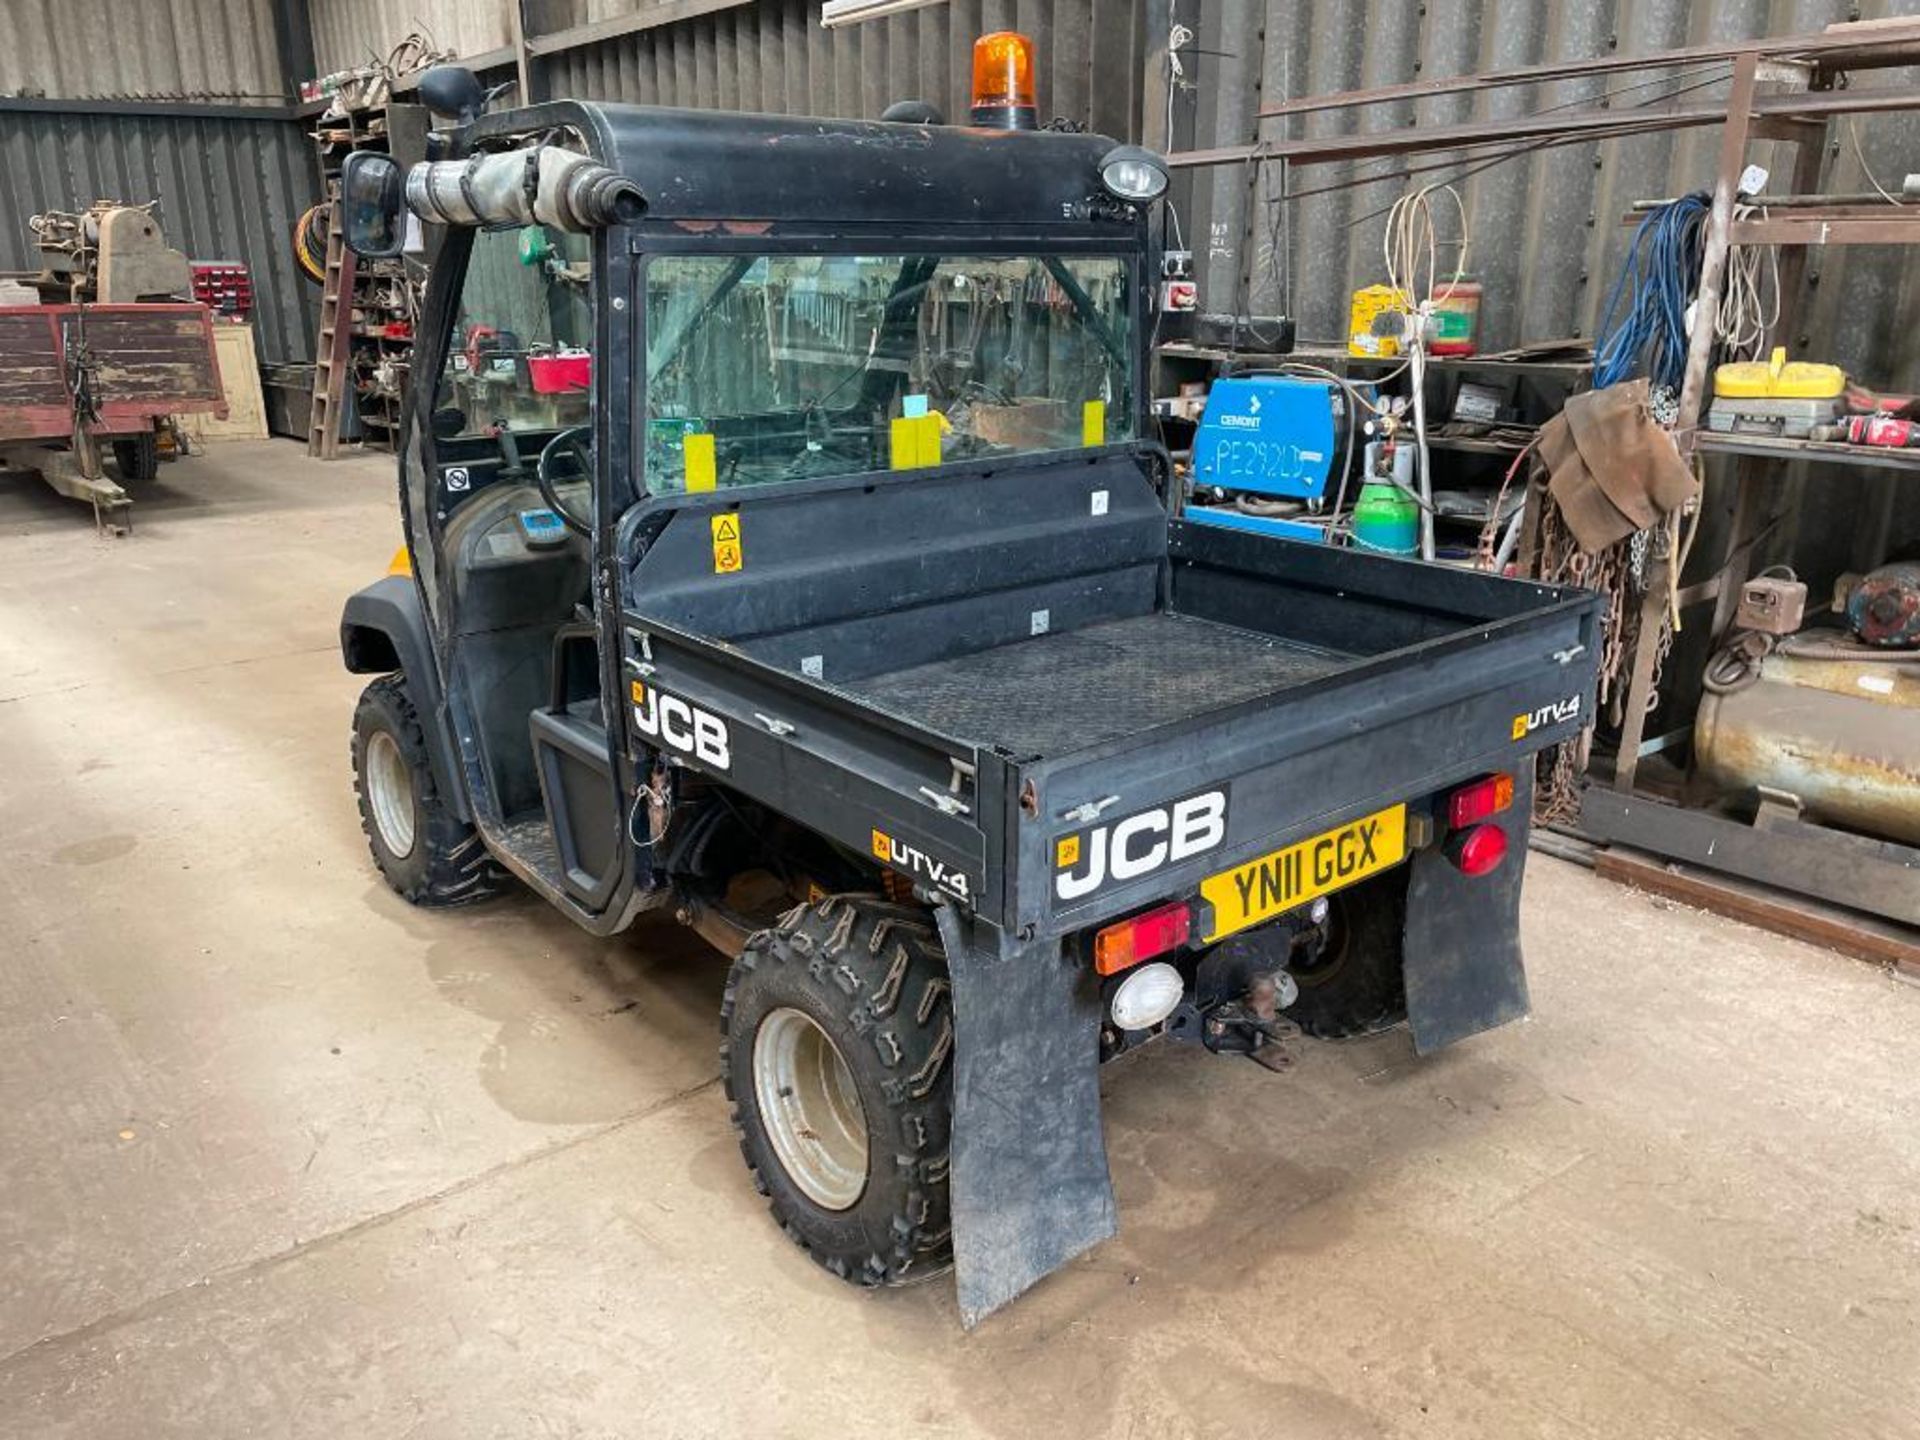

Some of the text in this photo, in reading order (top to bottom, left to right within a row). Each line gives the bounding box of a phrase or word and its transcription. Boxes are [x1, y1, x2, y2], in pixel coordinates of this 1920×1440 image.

[1220, 415, 1261, 428] CEMONT
[634, 687, 730, 770] JCB
[1527, 694, 1580, 730] UTV-4
[891, 838, 969, 897] UTV-4
[1056, 791, 1226, 900] JCB
[1234, 819, 1378, 918] YN11 GGX
